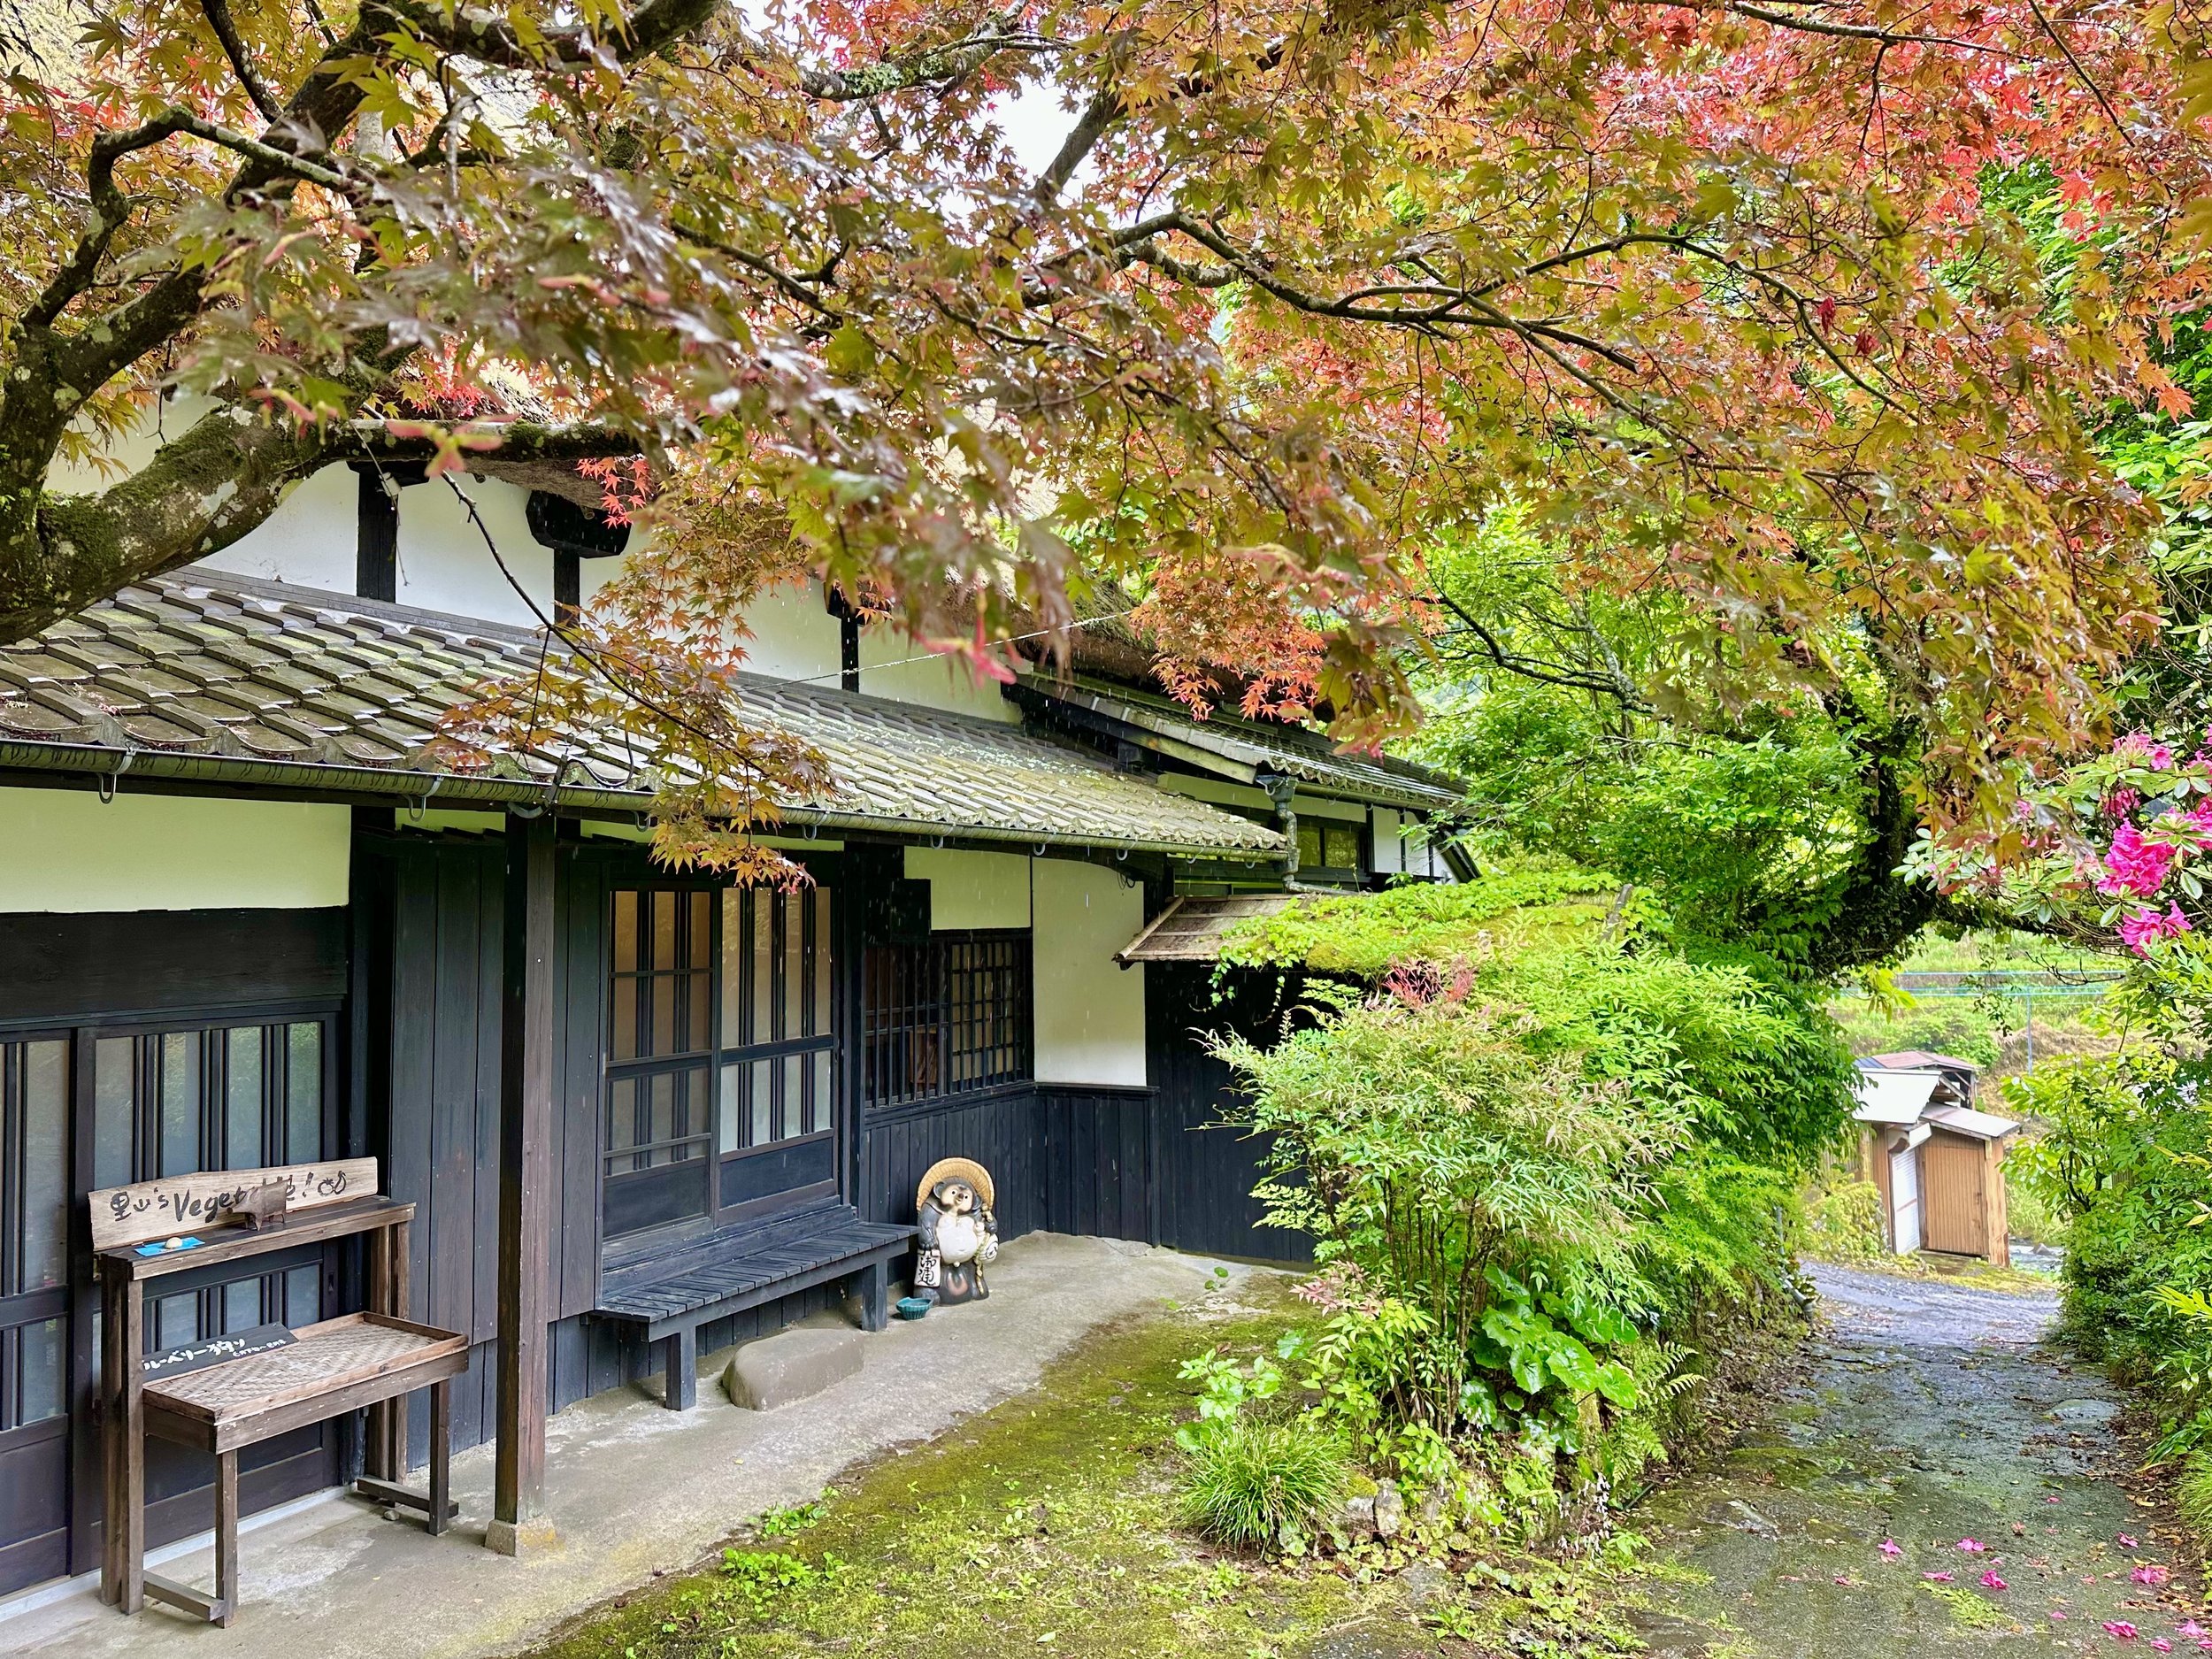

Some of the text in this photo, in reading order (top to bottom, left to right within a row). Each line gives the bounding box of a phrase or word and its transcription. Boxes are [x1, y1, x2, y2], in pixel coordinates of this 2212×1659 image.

[142, 1338, 246, 1371] ルーベリー狩り
